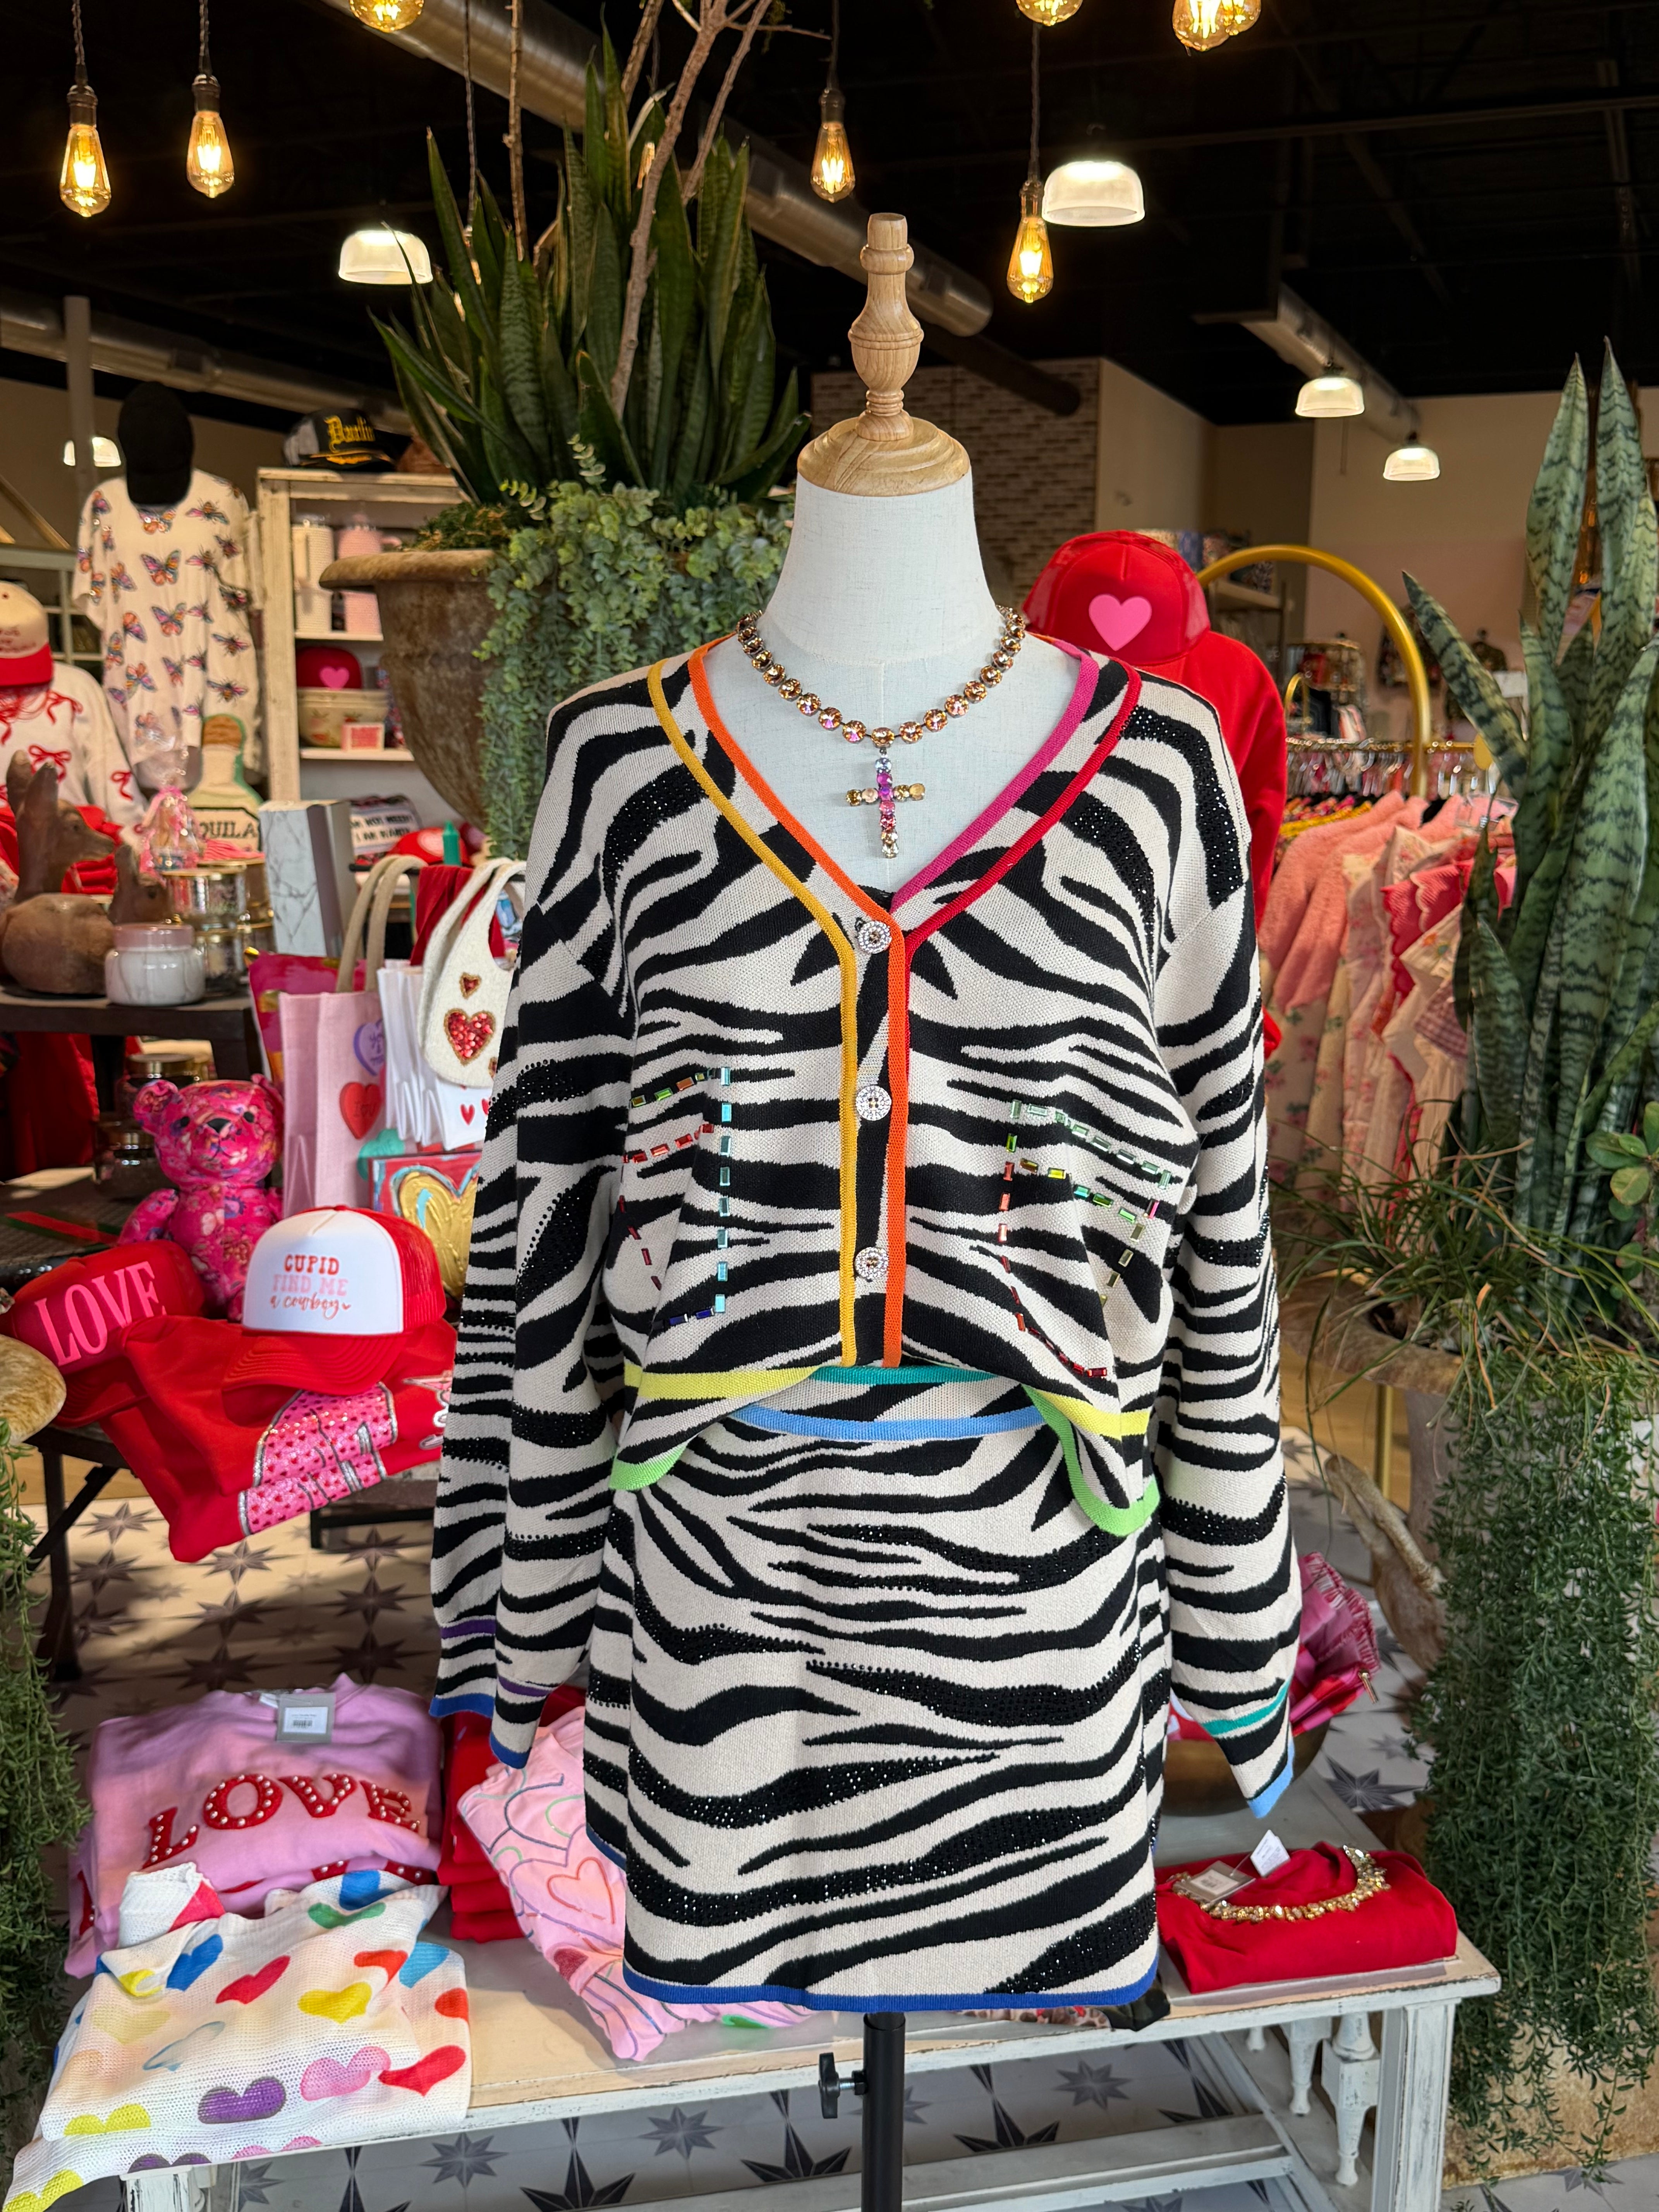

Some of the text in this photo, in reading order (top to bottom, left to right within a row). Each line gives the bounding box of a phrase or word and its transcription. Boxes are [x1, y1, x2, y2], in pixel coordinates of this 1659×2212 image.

[284, 1254, 340, 1275] CUPID
[272, 1274, 349, 1296] FIND ME
[34, 1261, 167, 1367] LOVE
[270, 1292, 339, 1321] a cowboy
[141, 1773, 421, 1869] LOVE
